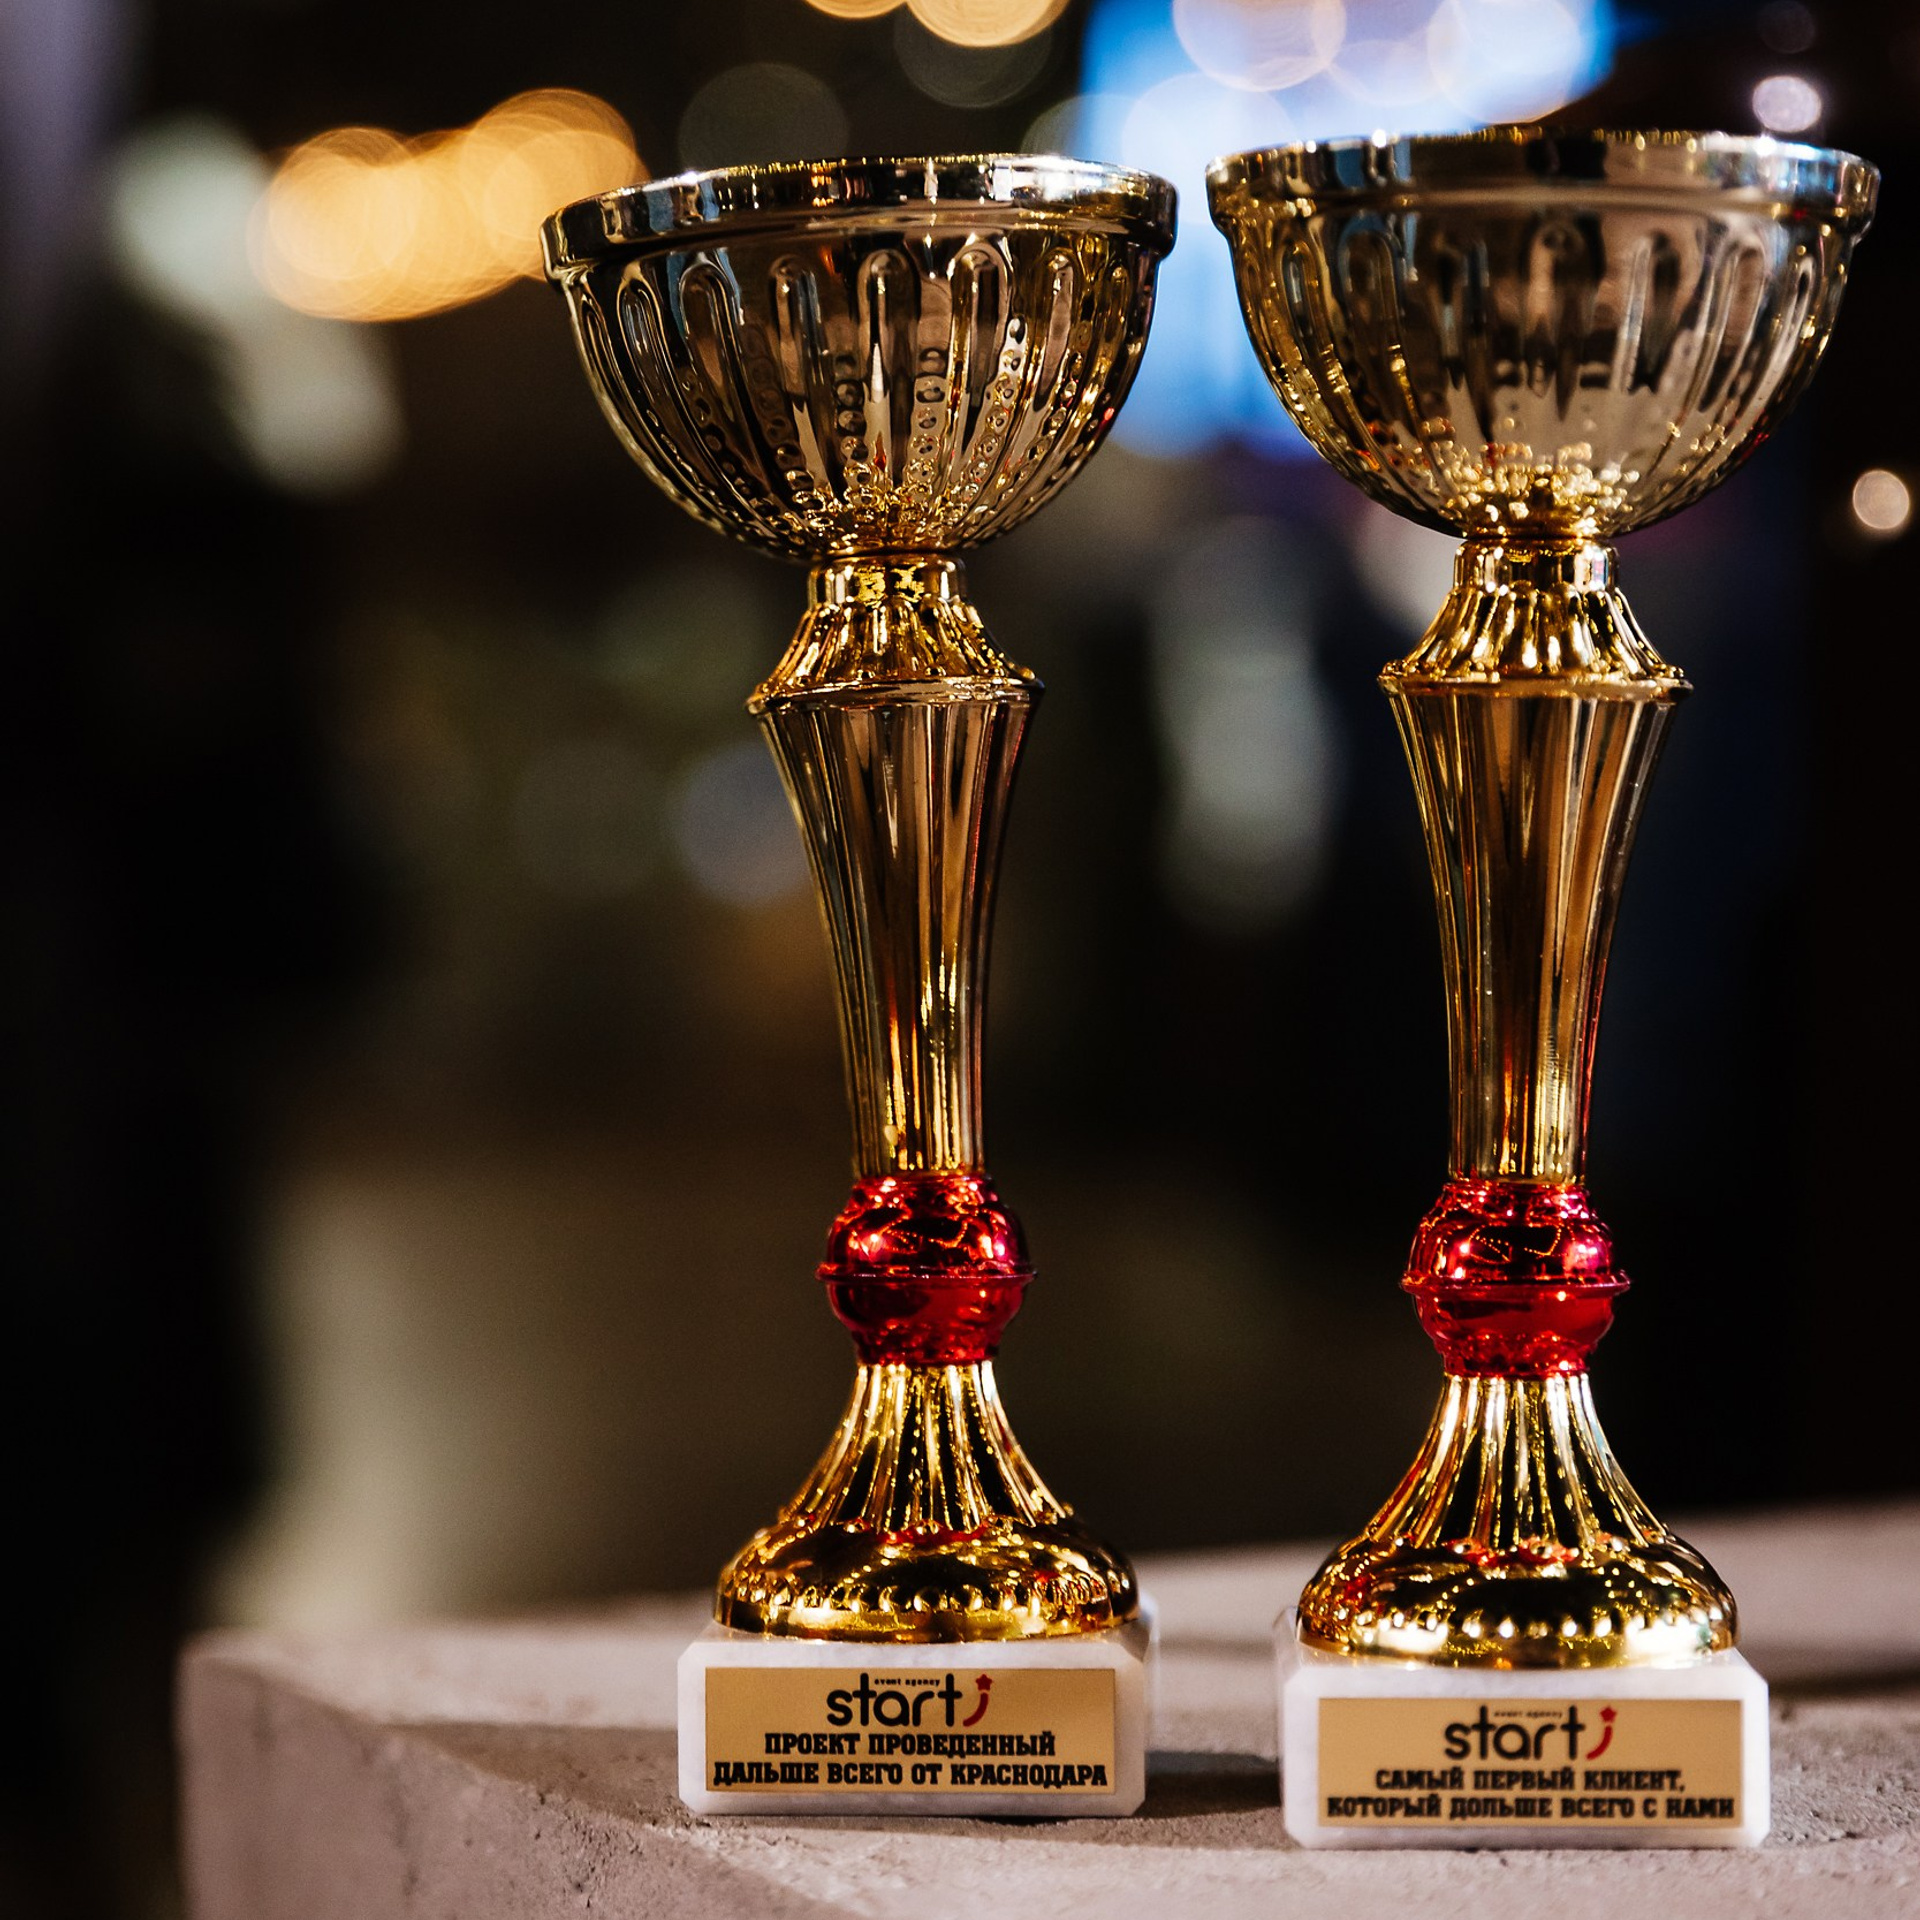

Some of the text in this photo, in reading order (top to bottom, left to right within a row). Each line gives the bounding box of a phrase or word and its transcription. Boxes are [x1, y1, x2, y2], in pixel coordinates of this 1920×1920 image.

[874, 1678, 940, 1688] event agency
[765, 1731, 1055, 1758] ПРОЕКТ ПРОВЕДЕННЫЙ
[713, 1761, 1107, 1789] ДАЛЬШЕ ВСЕГО ОТ КРАСНОДАРА
[1376, 1767, 1685, 1792] САМЫЙ ПЕРВЫЙ КЛИЕНТ,
[1327, 1797, 1734, 1820] КОТОРЫЙ ДОЛЬШЕ ВСЕГО С НАМИ
